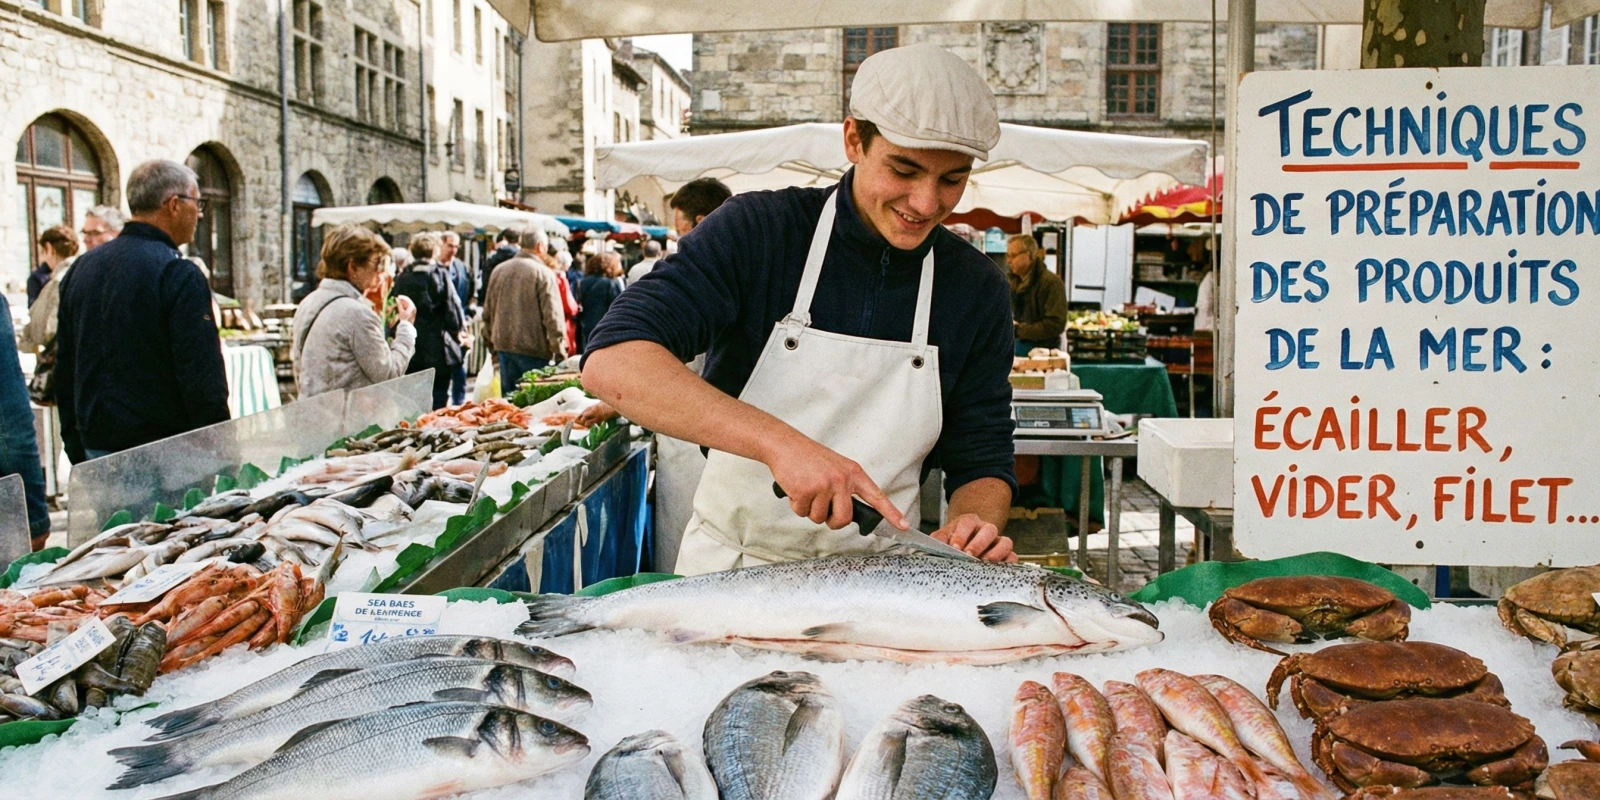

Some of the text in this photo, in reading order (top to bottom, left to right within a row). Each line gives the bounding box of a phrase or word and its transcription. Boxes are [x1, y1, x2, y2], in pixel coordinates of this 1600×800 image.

[1250, 193, 1306, 236] DE
[1250, 260, 1330, 304] DES
[1265, 327, 1320, 370] DE
[1340, 326, 1395, 371] LA
[1419, 326, 1527, 373] MER
[355, 607, 368, 615] DE
[367, 598, 386, 607] SEA
